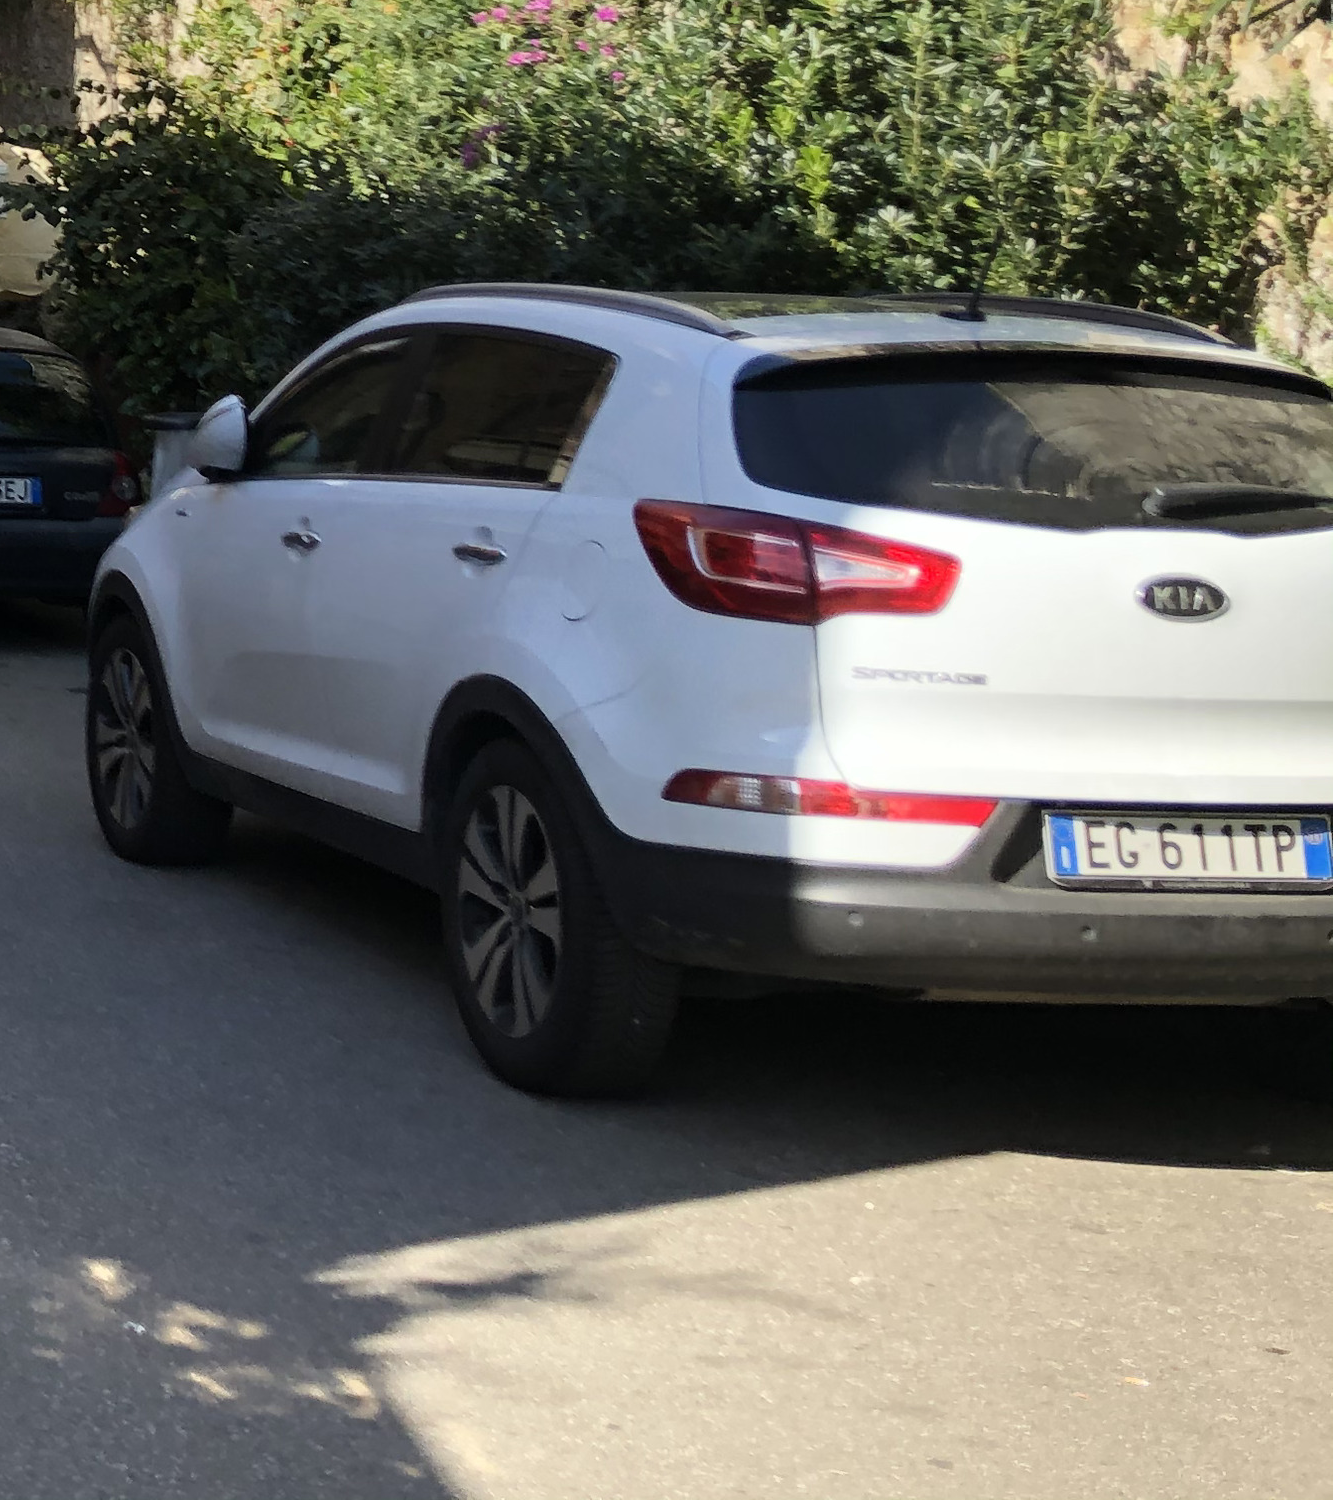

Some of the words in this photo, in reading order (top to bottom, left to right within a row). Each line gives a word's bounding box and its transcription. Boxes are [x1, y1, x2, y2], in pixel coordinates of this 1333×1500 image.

[1151, 585, 1217, 611] KIA
[850, 665, 988, 686] SPORTAGE
[1082, 819, 1140, 870] EG
[1156, 821, 1296, 873] 611TP
